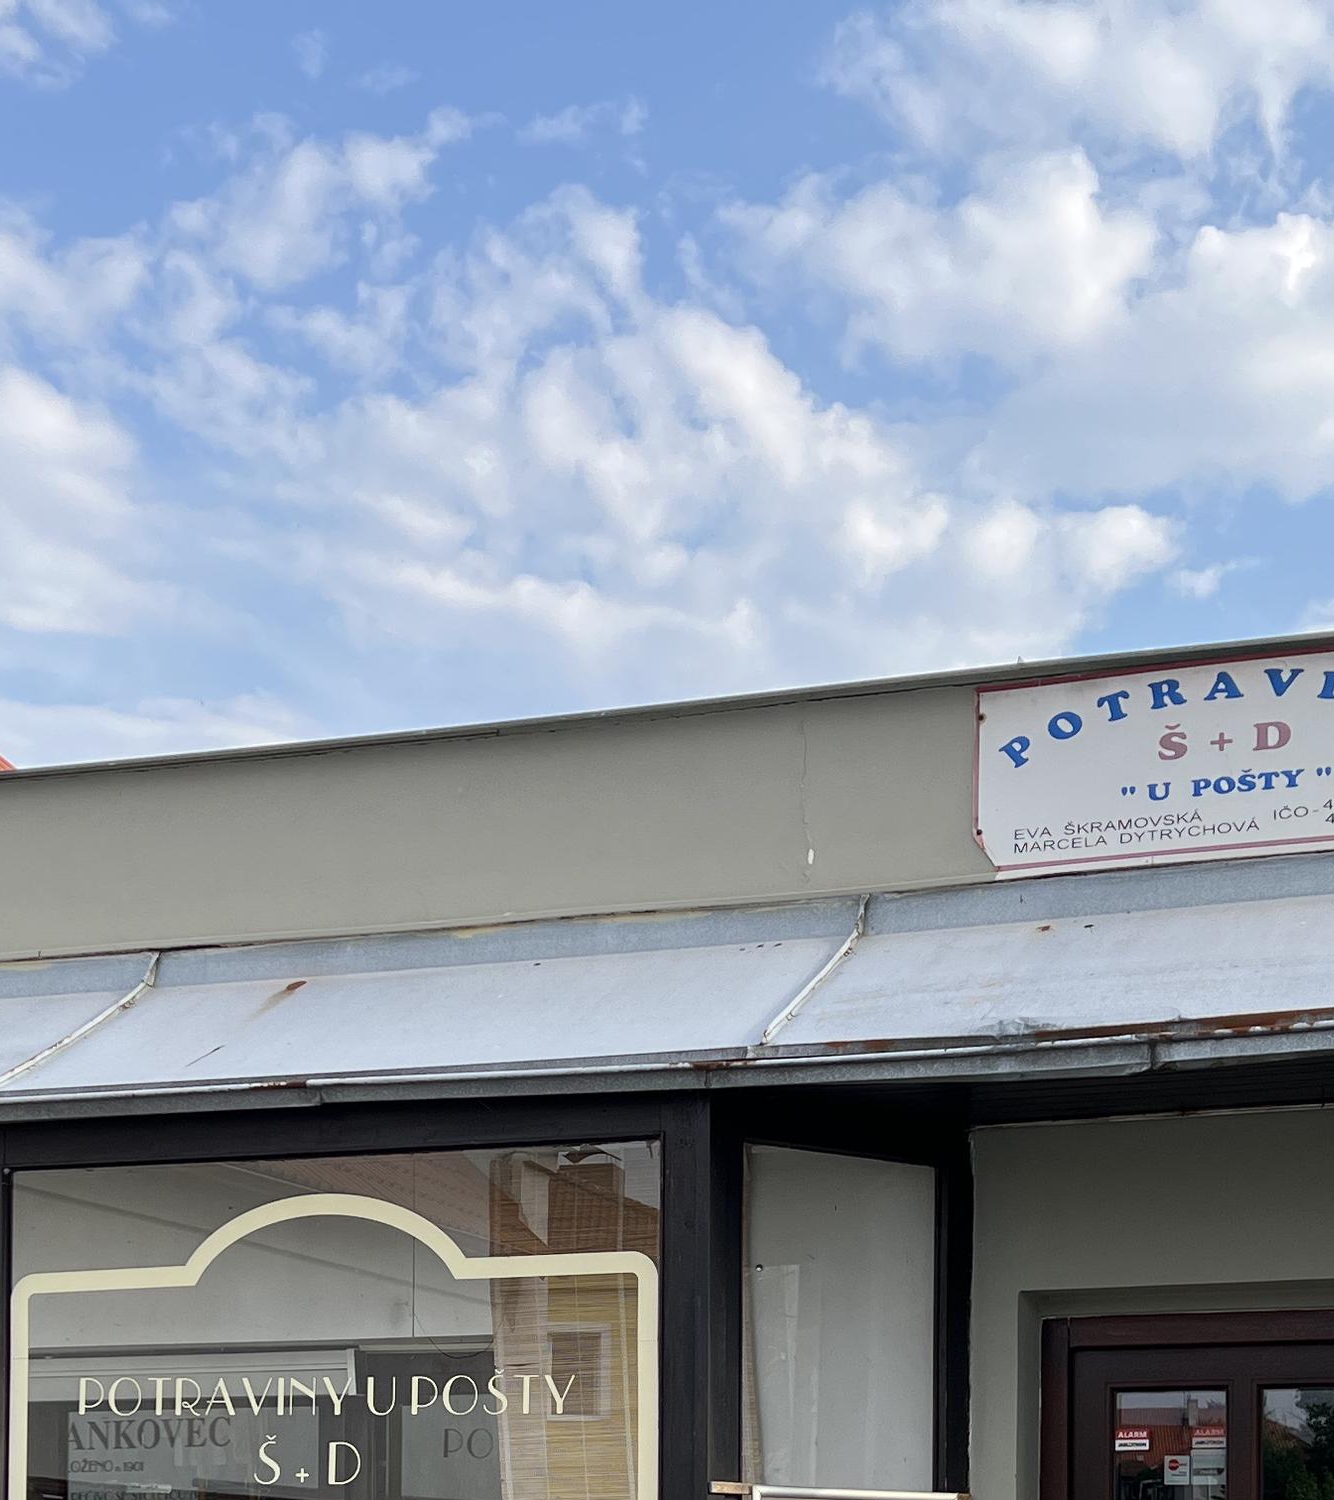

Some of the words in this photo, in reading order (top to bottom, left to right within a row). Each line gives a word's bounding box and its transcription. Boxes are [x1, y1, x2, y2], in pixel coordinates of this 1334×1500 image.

[1157, 723, 1189, 761] Š
[1210, 732, 1233, 752] +
[1253, 721, 1292, 752] D
[1013, 826, 1052, 841] EVA
[1063, 809, 1203, 836] ŠKRAMOVSKÁ
[1013, 835, 1108, 854] MARCELA
[1119, 817, 1260, 845] DYTRYCHOVÁ
[78, 1376, 353, 1416] POTRAVINY
[367, 1376, 397, 1416] U
[410, 1369, 576, 1416] POŠTY
[254, 1434, 282, 1485] Š
[295, 1467, 310, 1482] +
[328, 1441, 362, 1485] D
